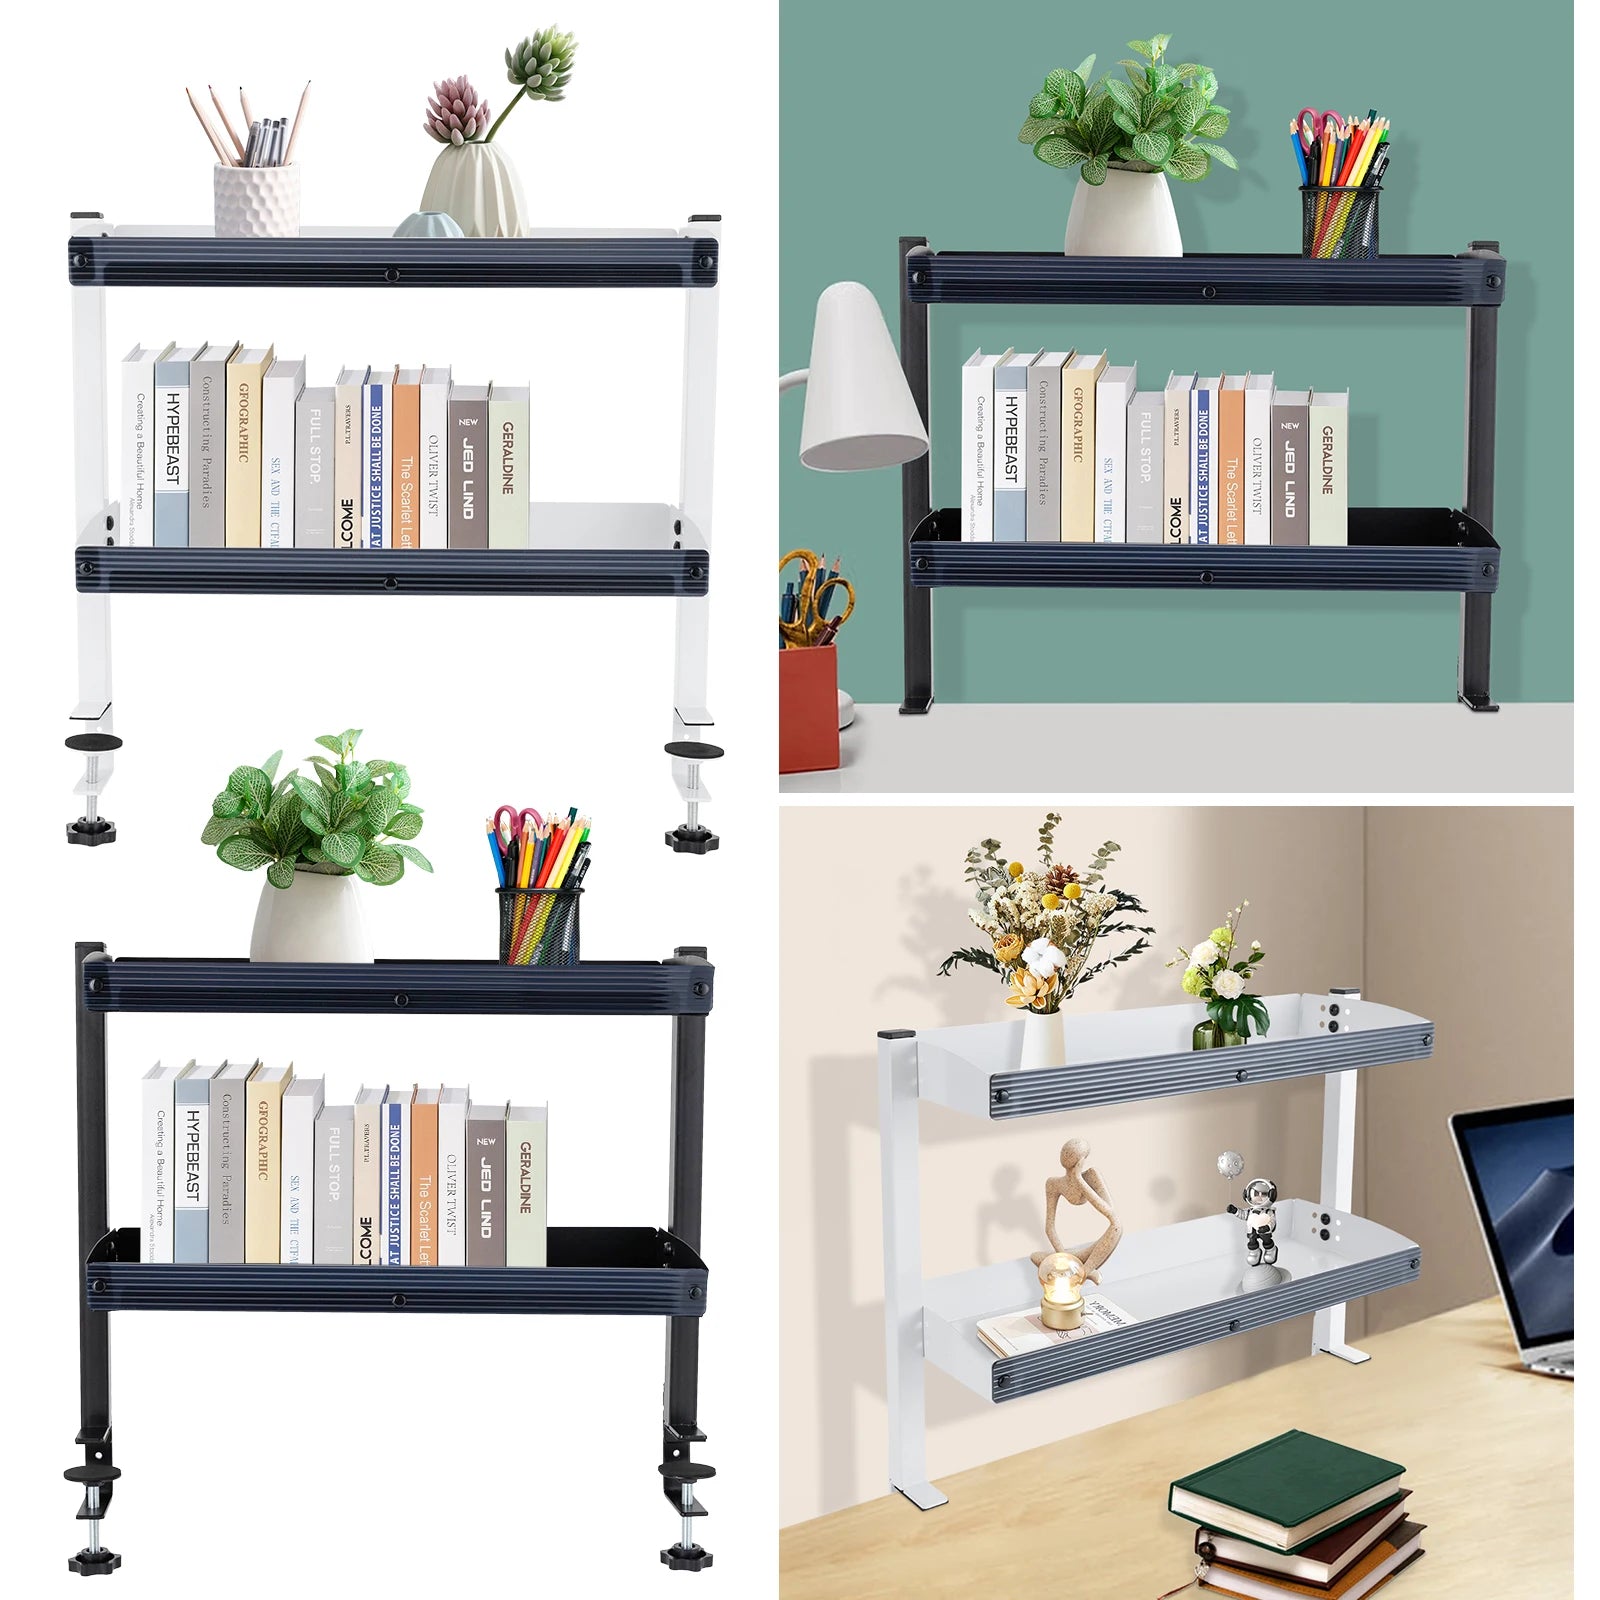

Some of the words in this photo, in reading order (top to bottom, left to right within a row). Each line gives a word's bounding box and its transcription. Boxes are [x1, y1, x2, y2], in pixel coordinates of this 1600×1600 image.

[135, 393, 145, 431] Creating
[201, 376, 213, 452] Constructing
[310, 409, 321, 442] FULL
[371, 405, 382, 434] DONE
[976, 396, 985, 432] Creating
[1038, 380, 1049, 453] Constructing
[1141, 412, 1152, 445] FULL
[1199, 409, 1209, 436] DONE
[166, 393, 180, 485] HYPEBEAST
[371, 436, 382, 449] BE
[428, 435, 439, 478] OLIVER
[463, 437, 474, 473] JED
[1005, 396, 1018, 483] HYPEBEAST
[1199, 438, 1209, 449] BE
[1285, 440, 1296, 474] JED
[136, 441, 145, 481] Beautiful
[271, 457, 280, 474] SEX
[310, 446, 321, 485] STOP.
[371, 451, 382, 482] SHALL
[400, 456, 414, 479] The
[502, 421, 514, 495] GERALDINE
[977, 442, 985, 479] Beautiful
[1103, 458, 1113, 474] SEX
[1141, 449, 1152, 484] STOP.
[1199, 452, 1209, 481] SHALL
[1227, 458, 1239, 480] The
[1253, 437, 1263, 479] OLIVER
[1322, 426, 1333, 495] GERALDINE
[136, 483, 145, 510] Home
[202, 458, 213, 509] Paradies
[271, 479, 280, 496] AND
[428, 479, 439, 517] TWIST
[977, 481, 985, 507] Home
[1039, 457, 1049, 506] Paradies
[1103, 478, 1113, 495] AND
[1253, 480, 1263, 515] TWIST
[1285, 481, 1296, 518] LIND
[271, 500, 280, 518] THE
[371, 485, 382, 528] JUSTICE
[400, 482, 414, 524] Scarlet
[463, 480, 474, 520] LIND
[1103, 499, 1113, 515] THE
[1199, 485, 1209, 526] JUSTICE
[1227, 482, 1239, 522] Scarlet
[155, 1110, 165, 1148] Creating
[221, 1093, 232, 1169] Constructing
[329, 1127, 340, 1161] FULL
[390, 1124, 400, 1152] DONE
[476, 1138, 496, 1146] NEW
[187, 1110, 199, 1202] HYPEBEAST
[390, 1154, 400, 1167] BE
[157, 1158, 165, 1197] Beautiful
[290, 1175, 300, 1192] SEX
[390, 1169, 400, 1200] SHALL
[419, 1175, 432, 1198] The
[446, 1154, 457, 1196] OLIVER
[480, 1157, 492, 1192] JED
[520, 1142, 531, 1214] GERALDINE
[156, 1200, 165, 1227] Home
[222, 1175, 232, 1225] Paradies
[290, 1197, 300, 1214] AND
[446, 1199, 457, 1236] TWIST
[290, 1219, 300, 1235] THE
[390, 1204, 400, 1247] JUSTICE
[419, 1201, 432, 1242] Scarlet
[480, 1199, 492, 1239] LIND
